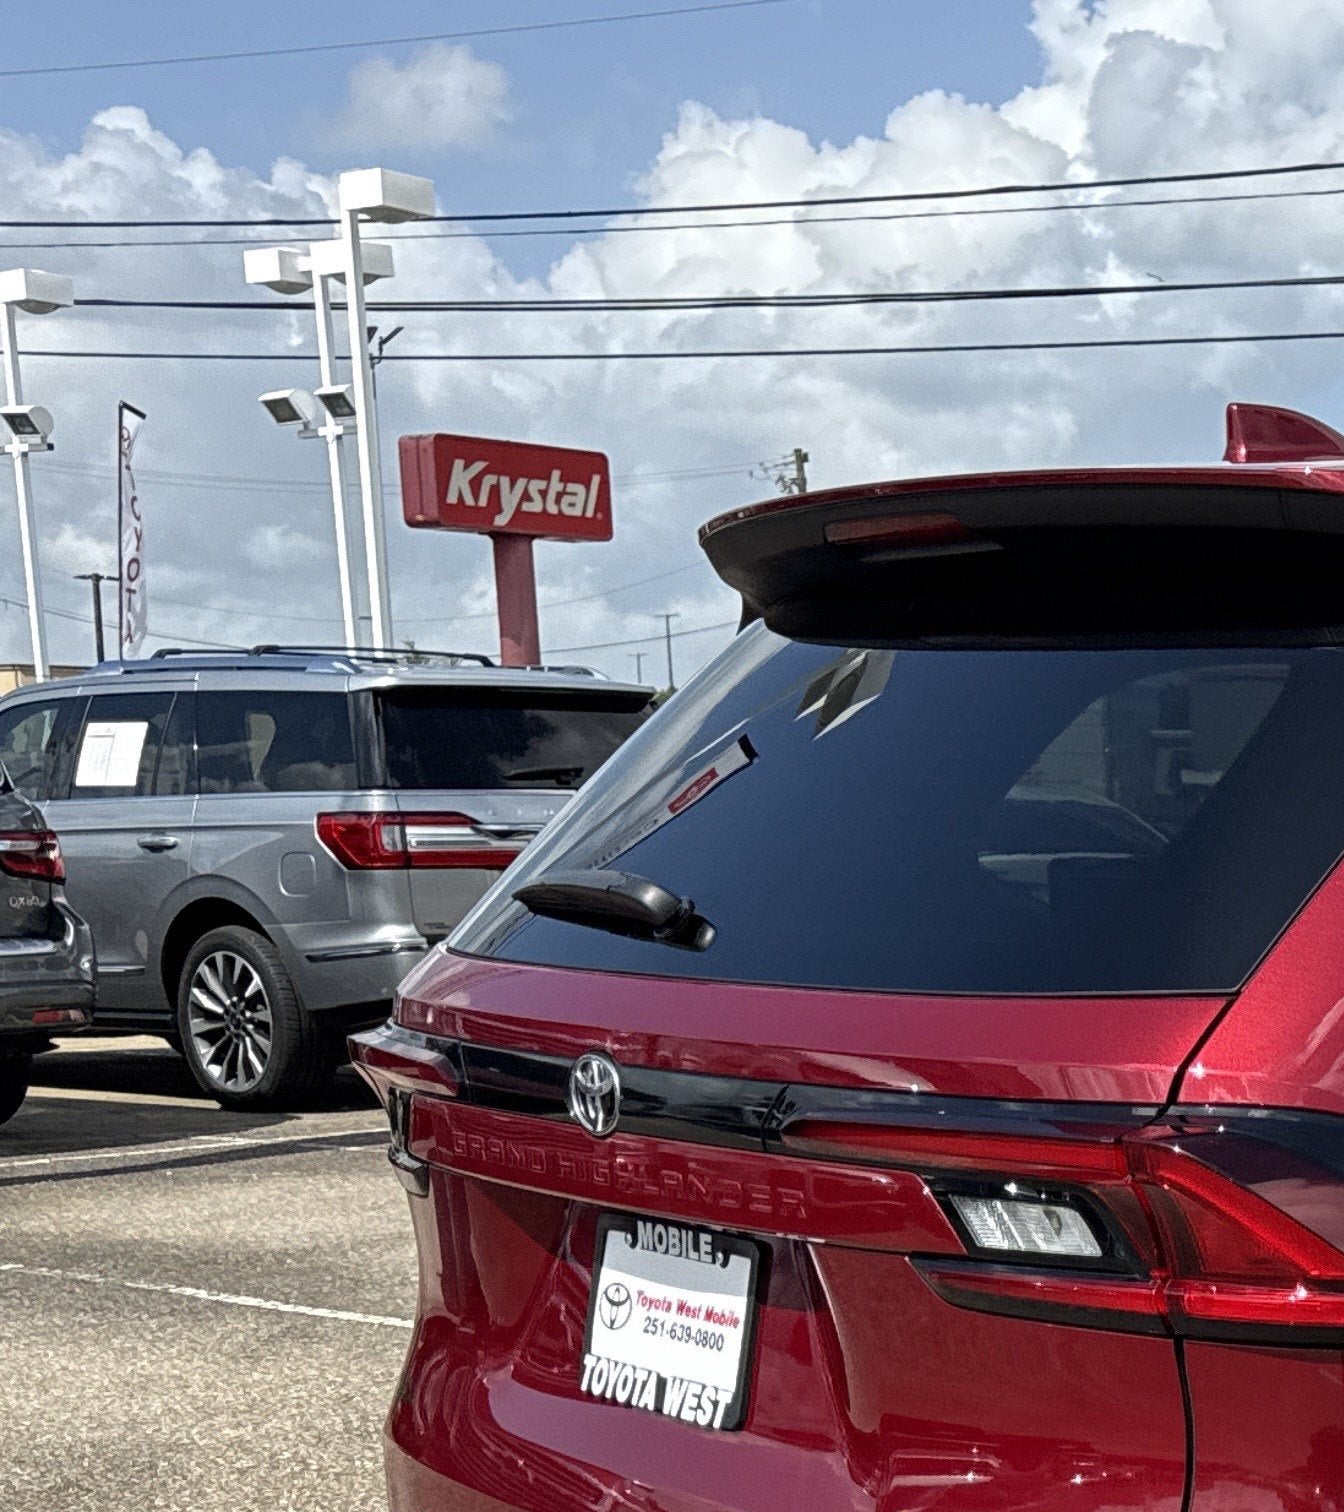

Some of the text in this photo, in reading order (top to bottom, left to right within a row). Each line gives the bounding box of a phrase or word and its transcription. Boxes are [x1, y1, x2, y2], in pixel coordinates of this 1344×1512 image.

[445, 458, 601, 527] Krystal
[450, 1130, 808, 1219] GRAND HIGHLANDER
[636, 1219, 714, 1264] MOBILE
[636, 1289, 741, 1330] Toyota West Mobile
[642, 1315, 725, 1352] 251-639-0800
[580, 1353, 733, 1430] TOYOTA WEST
